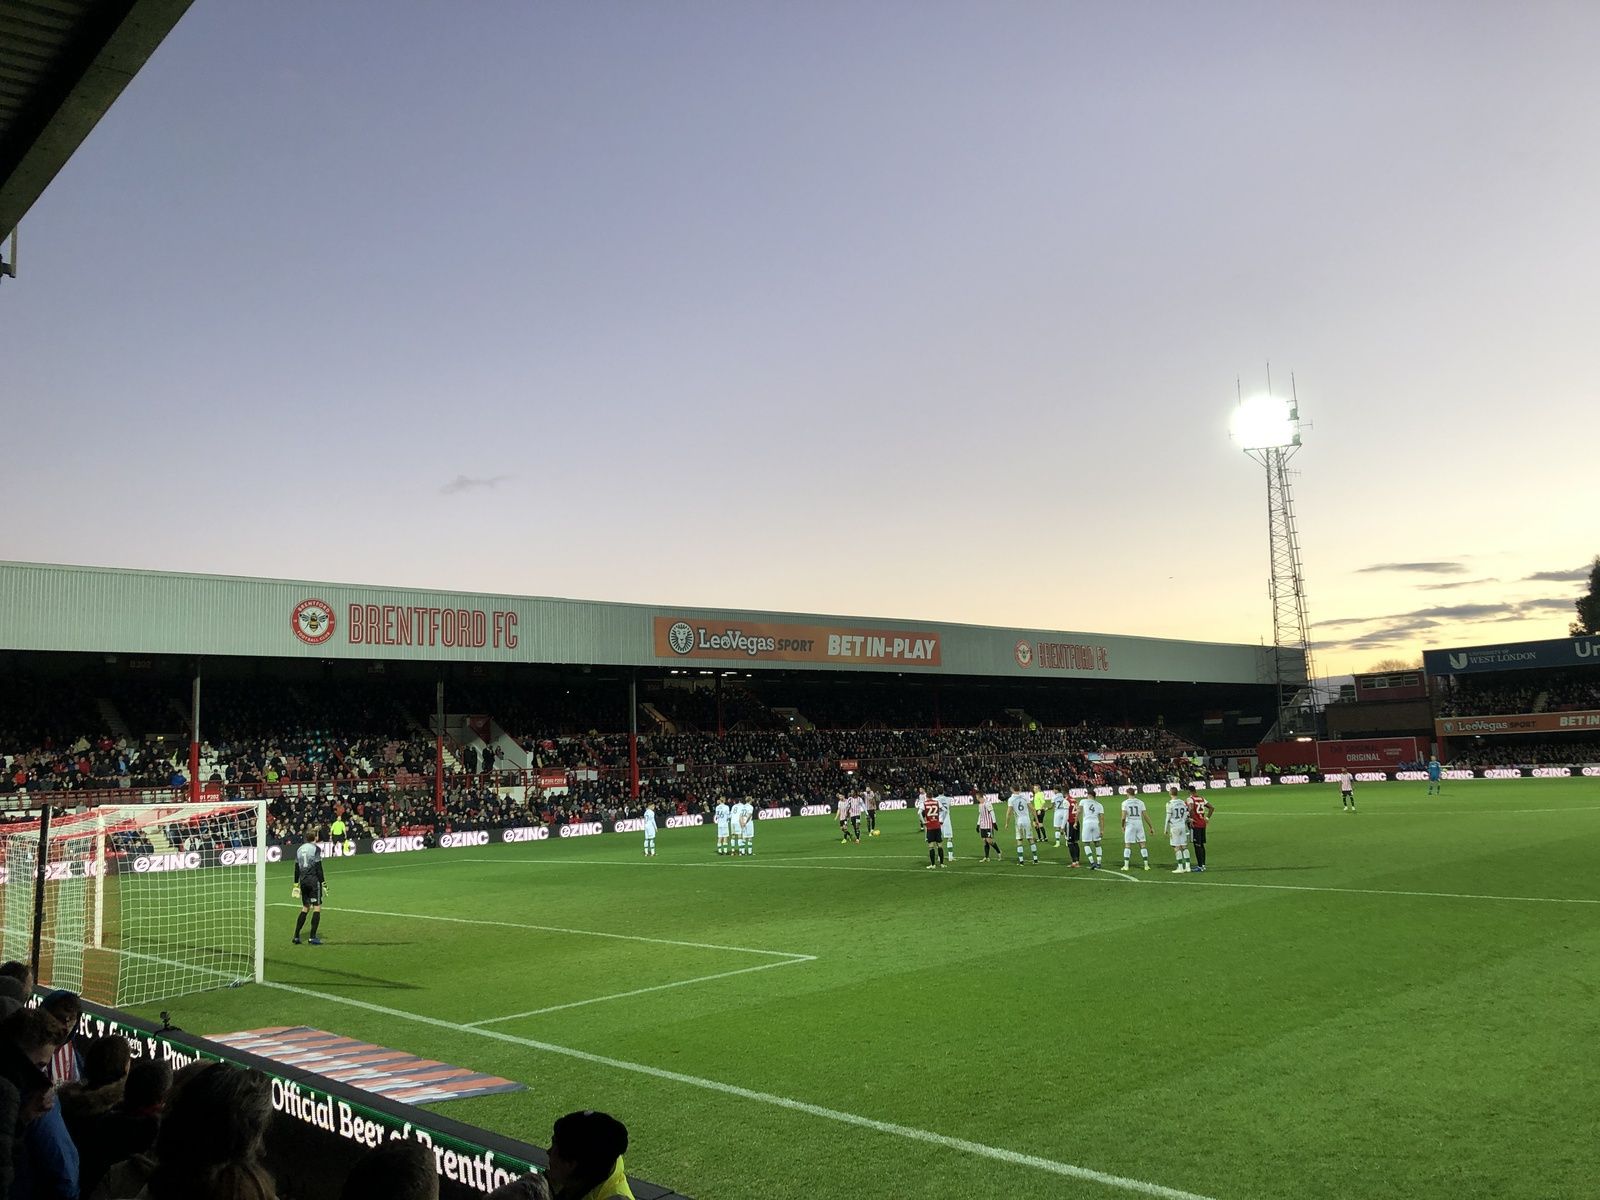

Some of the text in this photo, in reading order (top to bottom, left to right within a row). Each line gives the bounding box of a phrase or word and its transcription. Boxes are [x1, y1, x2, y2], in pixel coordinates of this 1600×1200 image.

[349, 604, 518, 649] BRENTFORD FC
[698, 628, 936, 660] LeoVegas SPORT BET IN-PLAY
[1037, 643, 1109, 671] BRENTFORD FC
[1470, 652, 1537, 664] WEST LONDON
[1457, 720, 1508, 732] LeoVegas
[1559, 716, 1585, 727] BET
[1346, 753, 1381, 762] ORIGINAL
[1360, 772, 1387, 781] ZINC
[1403, 771, 1430, 780] ZINC
[1447, 769, 1474, 779] ZINC
[1492, 769, 1521, 778] ZINC
[1540, 767, 1571, 777] ZINC
[1287, 775, 1309, 785] ZINC
[1324, 774, 1341, 783] ZIN
[1071, 788, 1088, 798] ZINC
[886, 800, 908, 811] ZINC
[954, 795, 974, 806] ZINC
[1018, 801, 1024, 811] 6
[766, 807, 792, 820] ZINC
[807, 804, 832, 816] ZINC
[925, 805, 939, 816] 22
[1089, 804, 1096, 813] 4
[1128, 806, 1140, 816] 11
[1174, 807, 1185, 819] 19
[623, 818, 645, 832] ZIN
[674, 814, 704, 827] ZINC
[513, 826, 549, 842] ZINC
[569, 821, 602, 837] ZINC
[385, 835, 425, 852] ZINC
[449, 830, 490, 847] ZINC
[151, 852, 201, 870] ZINC
[302, 852, 309, 868] 1
[80, 1012, 93, 1039] FC
[271, 1077, 336, 1132] Official
[338, 1101, 385, 1148] Beer
[416, 1129, 538, 1194] rentfo
